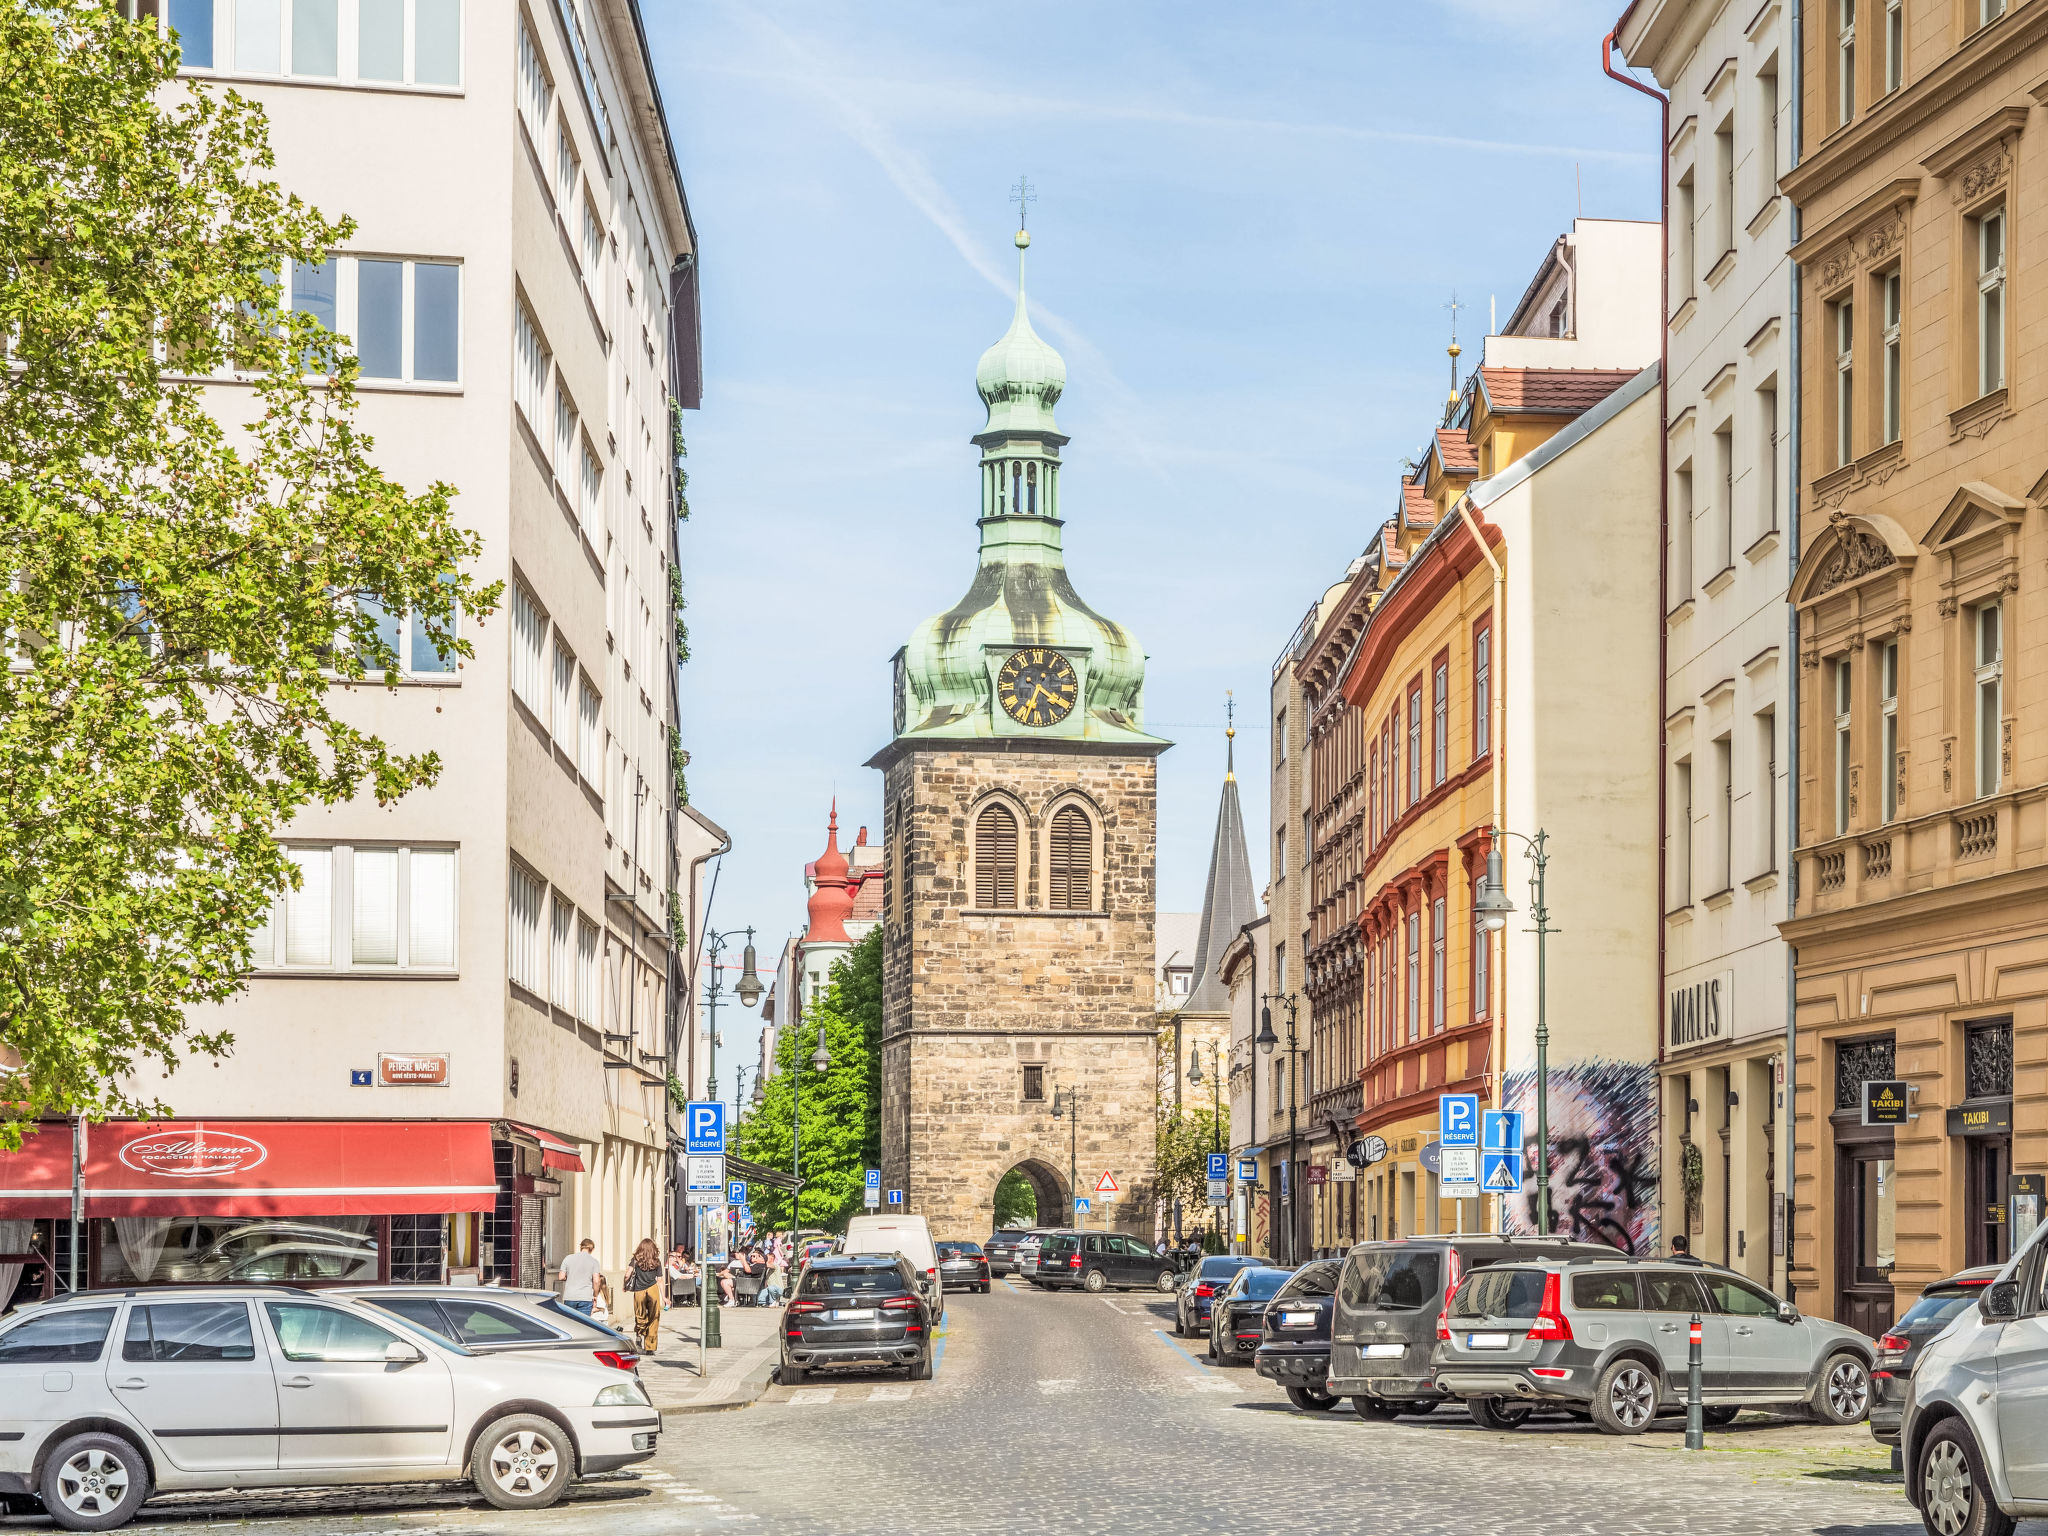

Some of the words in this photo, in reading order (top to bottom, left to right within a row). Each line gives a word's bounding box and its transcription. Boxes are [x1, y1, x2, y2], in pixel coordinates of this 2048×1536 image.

[1032, 651, 1043, 664] XII
[1005, 665, 1019, 678] X
[1001, 681, 1014, 691] IX
[358, 1072, 366, 1083] 4
[1871, 1099, 1904, 1108] TAKIBI
[1448, 1101, 1470, 1131] P
[1962, 1111, 1989, 1125] TAKIBI
[695, 1108, 717, 1138] P
[1211, 1156, 1224, 1172] P
[1335, 1161, 1341, 1170] F
[868, 1172, 878, 1183] P
[731, 1184, 743, 1198] P
